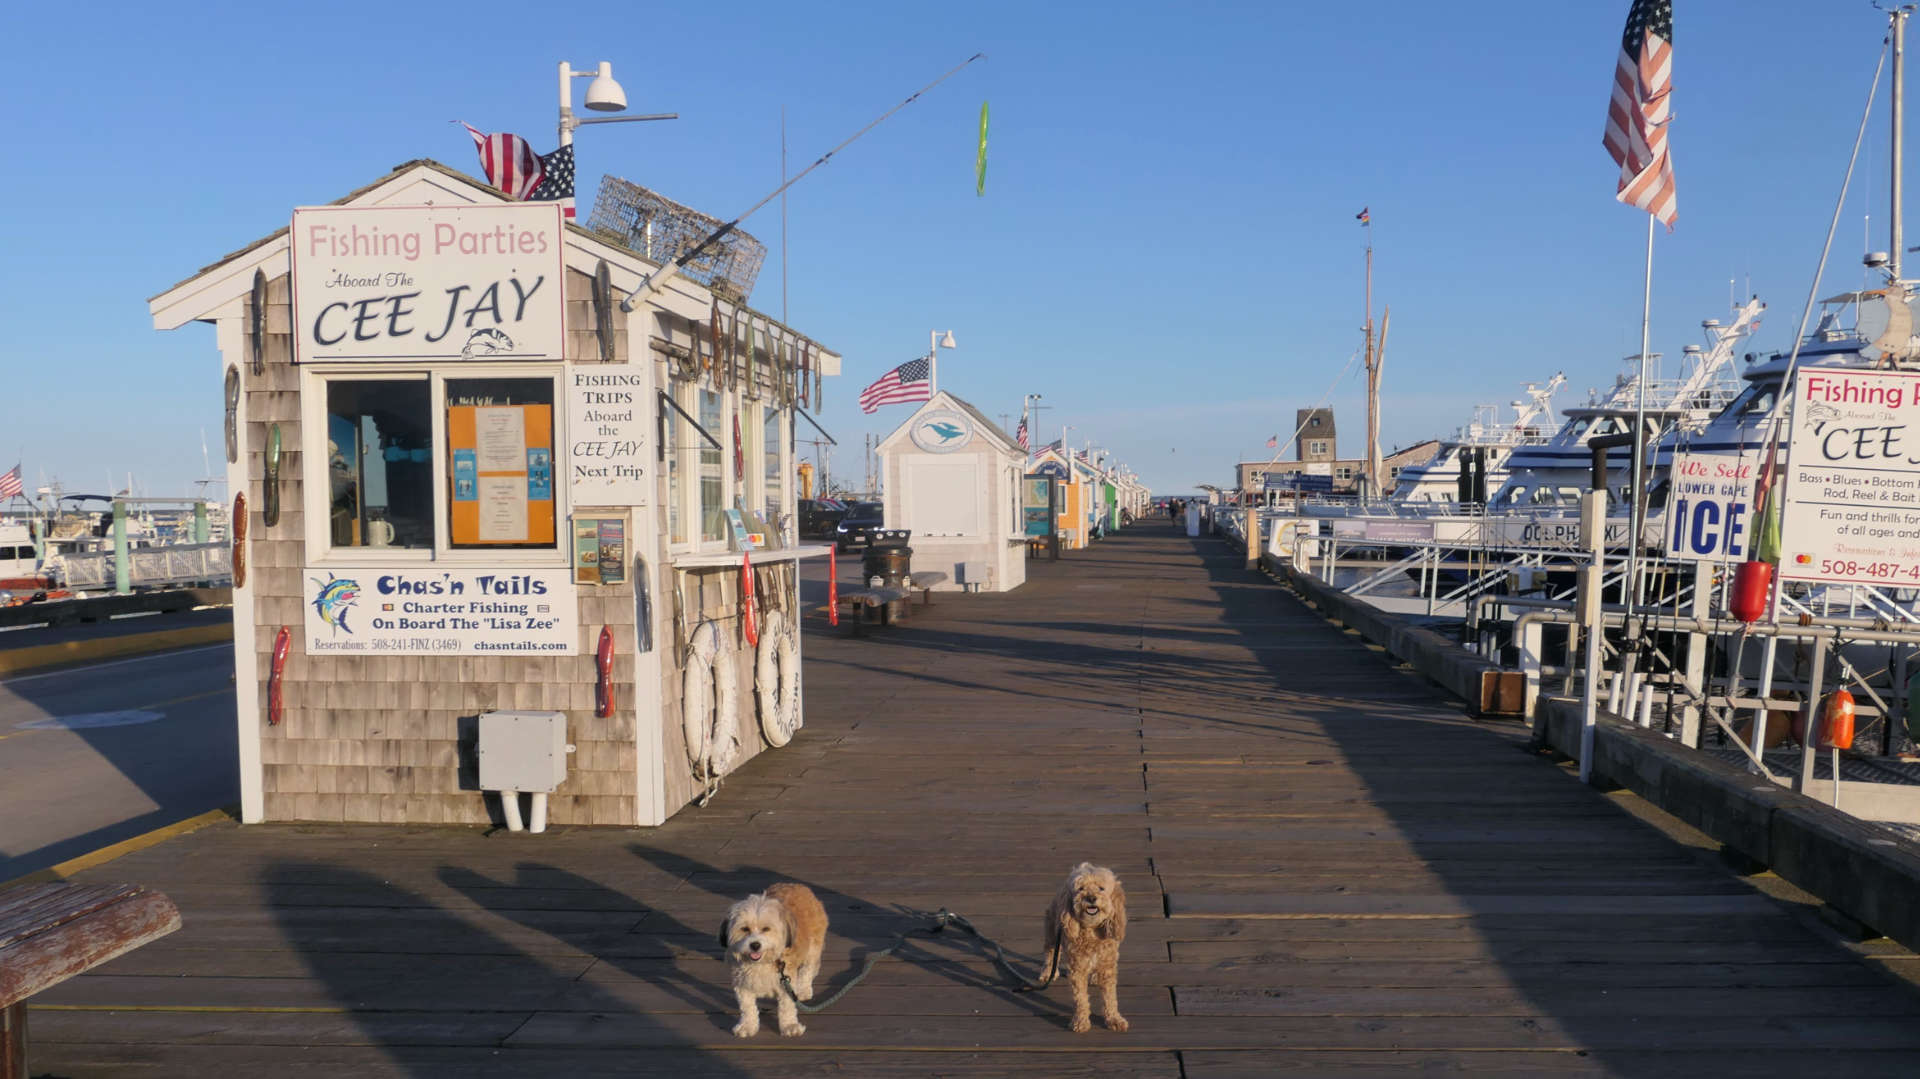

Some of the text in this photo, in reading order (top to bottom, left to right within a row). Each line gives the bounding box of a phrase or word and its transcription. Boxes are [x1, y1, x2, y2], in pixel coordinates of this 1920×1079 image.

[309, 223, 548, 261] Fishing Parties
[325, 272, 414, 289] Aboard The
[313, 275, 545, 346] CEE JAY
[575, 374, 641, 386] FISHING
[583, 391, 633, 404] TRIPS
[1807, 377, 1902, 409] Fishing
[584, 410, 632, 422] Aboard
[598, 425, 619, 436] the
[573, 441, 644, 460] CEE JAY
[1822, 425, 1906, 461] CEE
[575, 465, 643, 481] Next Trip
[1678, 461, 1752, 479] We Sell
[1799, 472, 1914, 489] Bass Blues Bottom
[1678, 483, 1748, 498] LOWER CAPE
[1824, 488, 1916, 503] Rod, Reel & Bait
[1820, 509, 1920, 525] Fun and thrills for
[1672, 499, 1746, 556] ICE
[1837, 524, 1920, 539] of all ages and
[377, 573, 548, 595] Chas'n Tails
[403, 602, 465, 613] Charter
[470, 602, 529, 616] Fishing
[373, 618, 560, 629] On Board The "Lisa Zee"
[314, 638, 567, 652] Reservations: 508-241-FINZ (3469) chasntails.com
